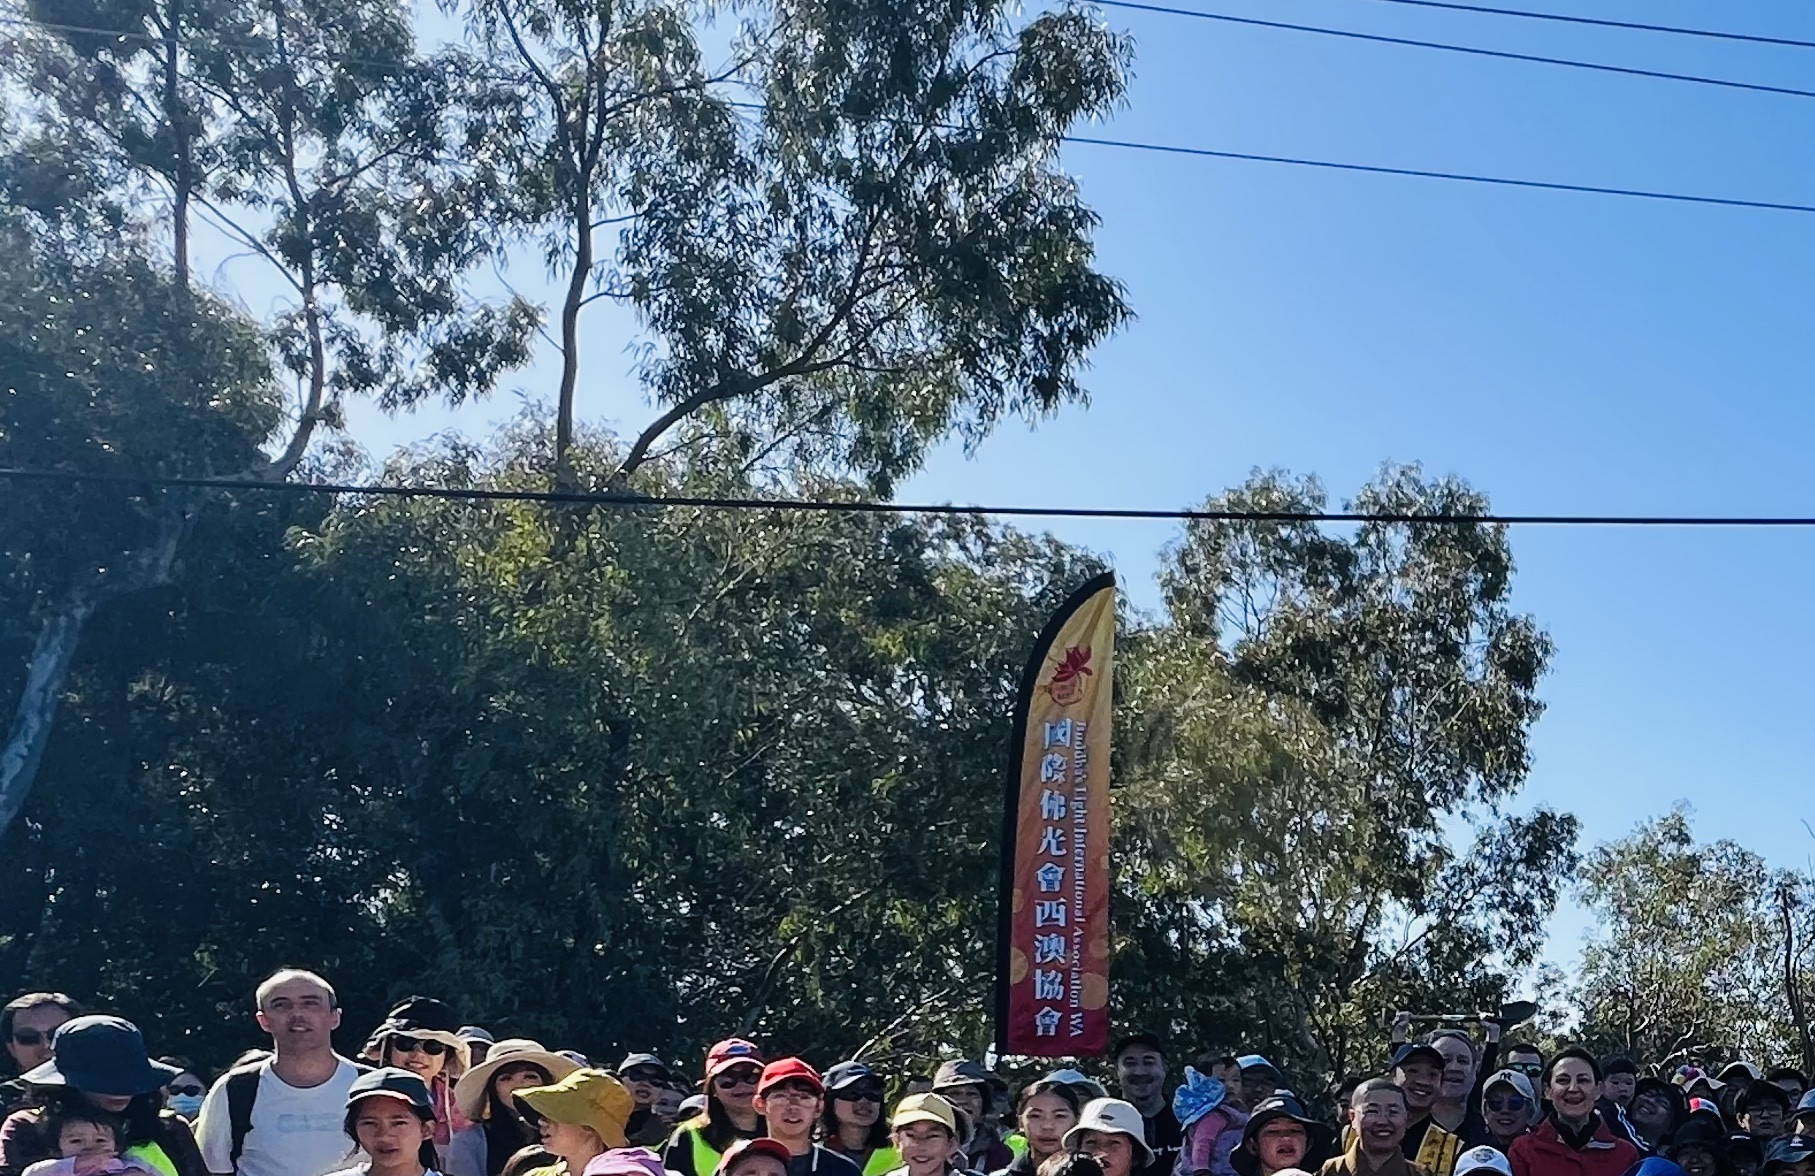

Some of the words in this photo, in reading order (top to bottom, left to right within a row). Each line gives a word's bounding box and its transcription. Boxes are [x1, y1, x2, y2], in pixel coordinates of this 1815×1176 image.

[1070, 787, 1087, 824] Light
[1074, 827, 1087, 922] International
[1070, 926, 1085, 1008] Association
[1069, 1012, 1084, 1037] WA
